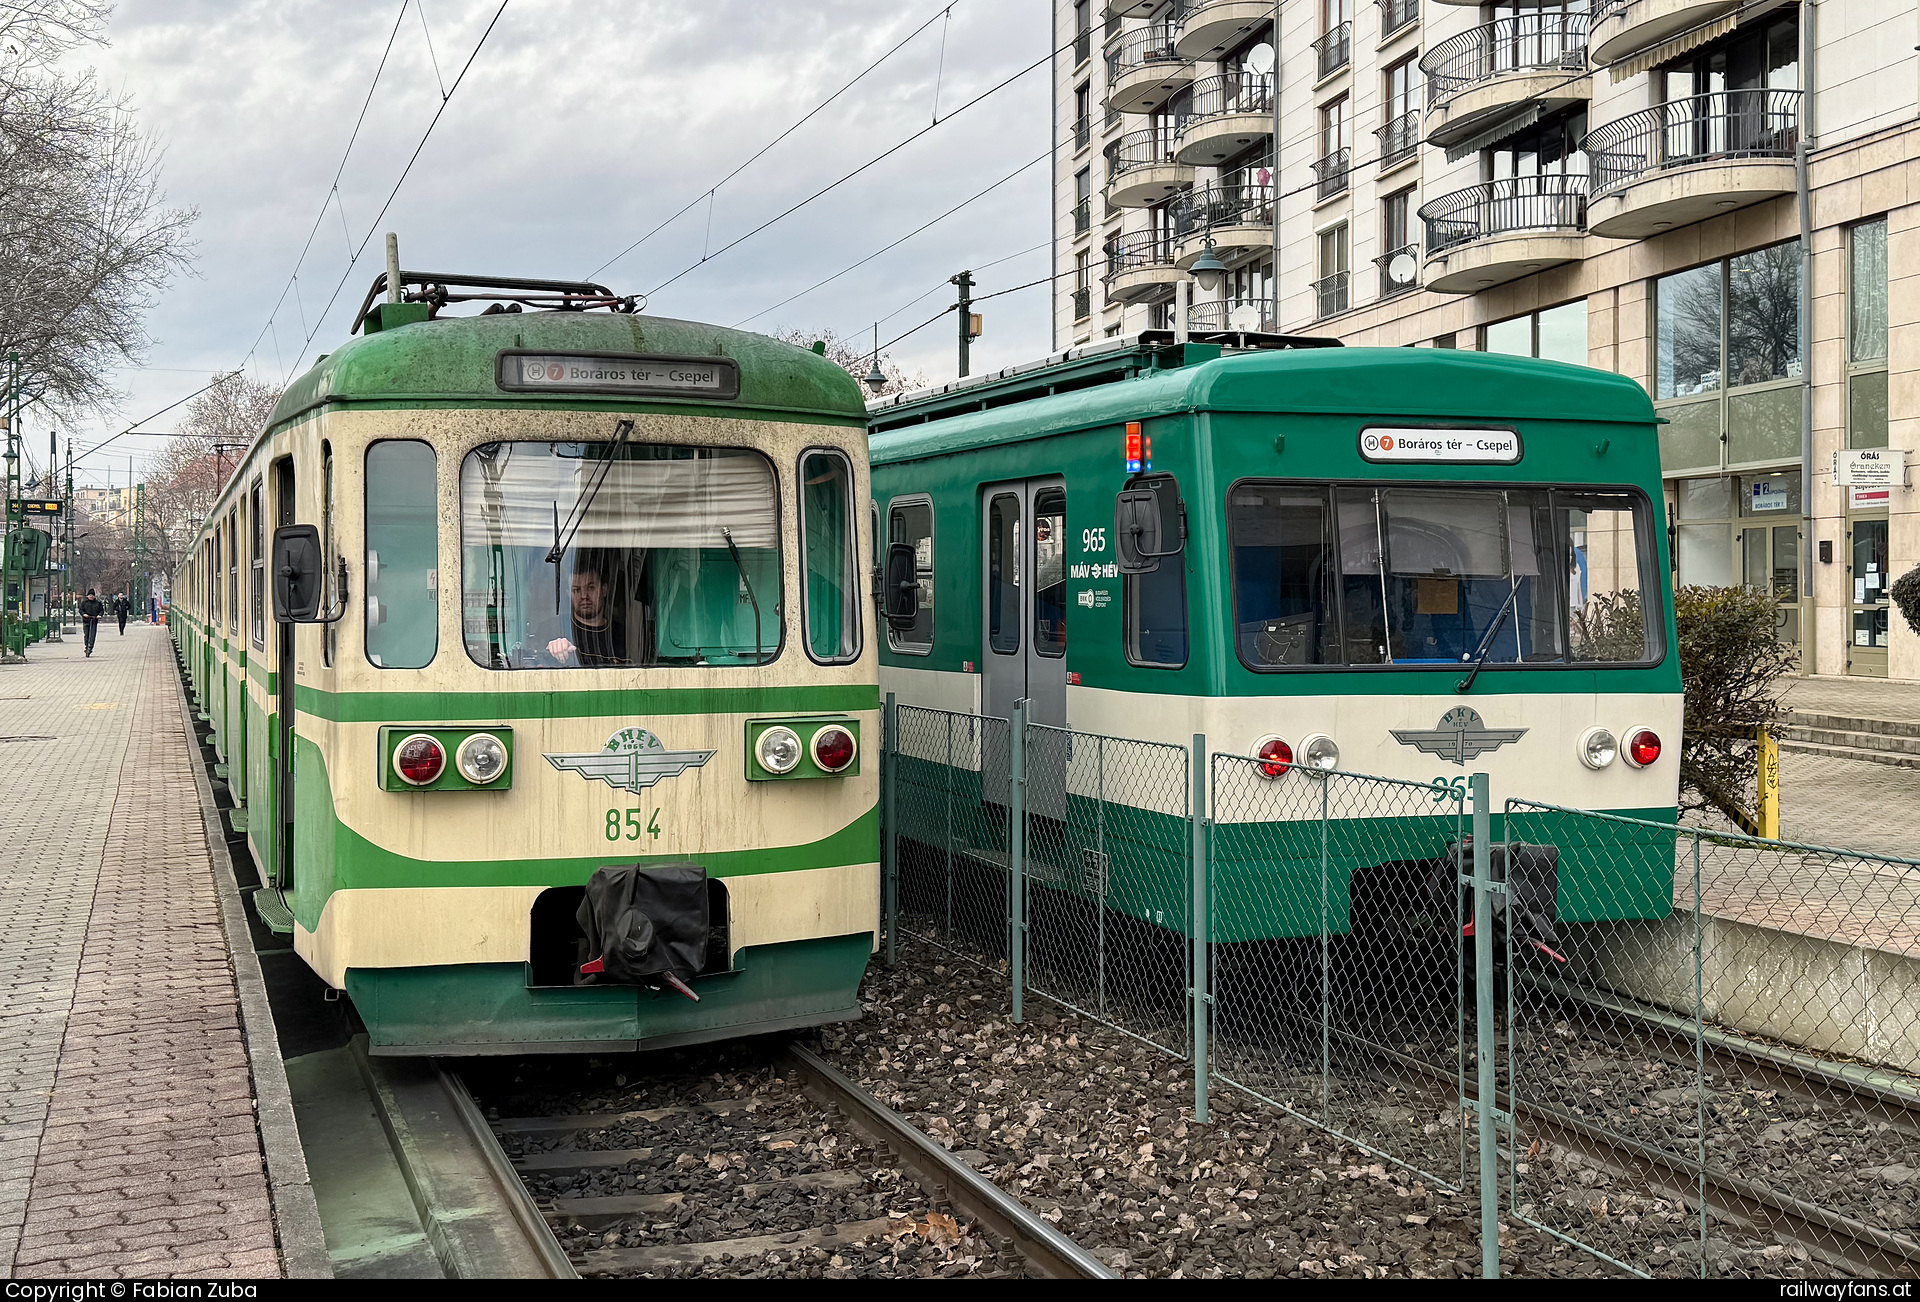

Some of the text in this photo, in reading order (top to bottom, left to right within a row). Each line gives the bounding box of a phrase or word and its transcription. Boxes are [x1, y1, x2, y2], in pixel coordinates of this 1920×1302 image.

[570, 366, 626, 381] Boráros
[631, 368, 651, 381] tér
[668, 370, 714, 385] Csepel
[1398, 437, 1443, 450] Boráros
[1446, 438, 1463, 450] tér
[1476, 439, 1513, 453] Csepel
[1860, 451, 1880, 460] ÓRÁS
[1082, 527, 1106, 552] 965
[1070, 561, 1118, 578] MÁV HÉV
[1443, 708, 1480, 724] BKV
[605, 807, 661, 841] 854
